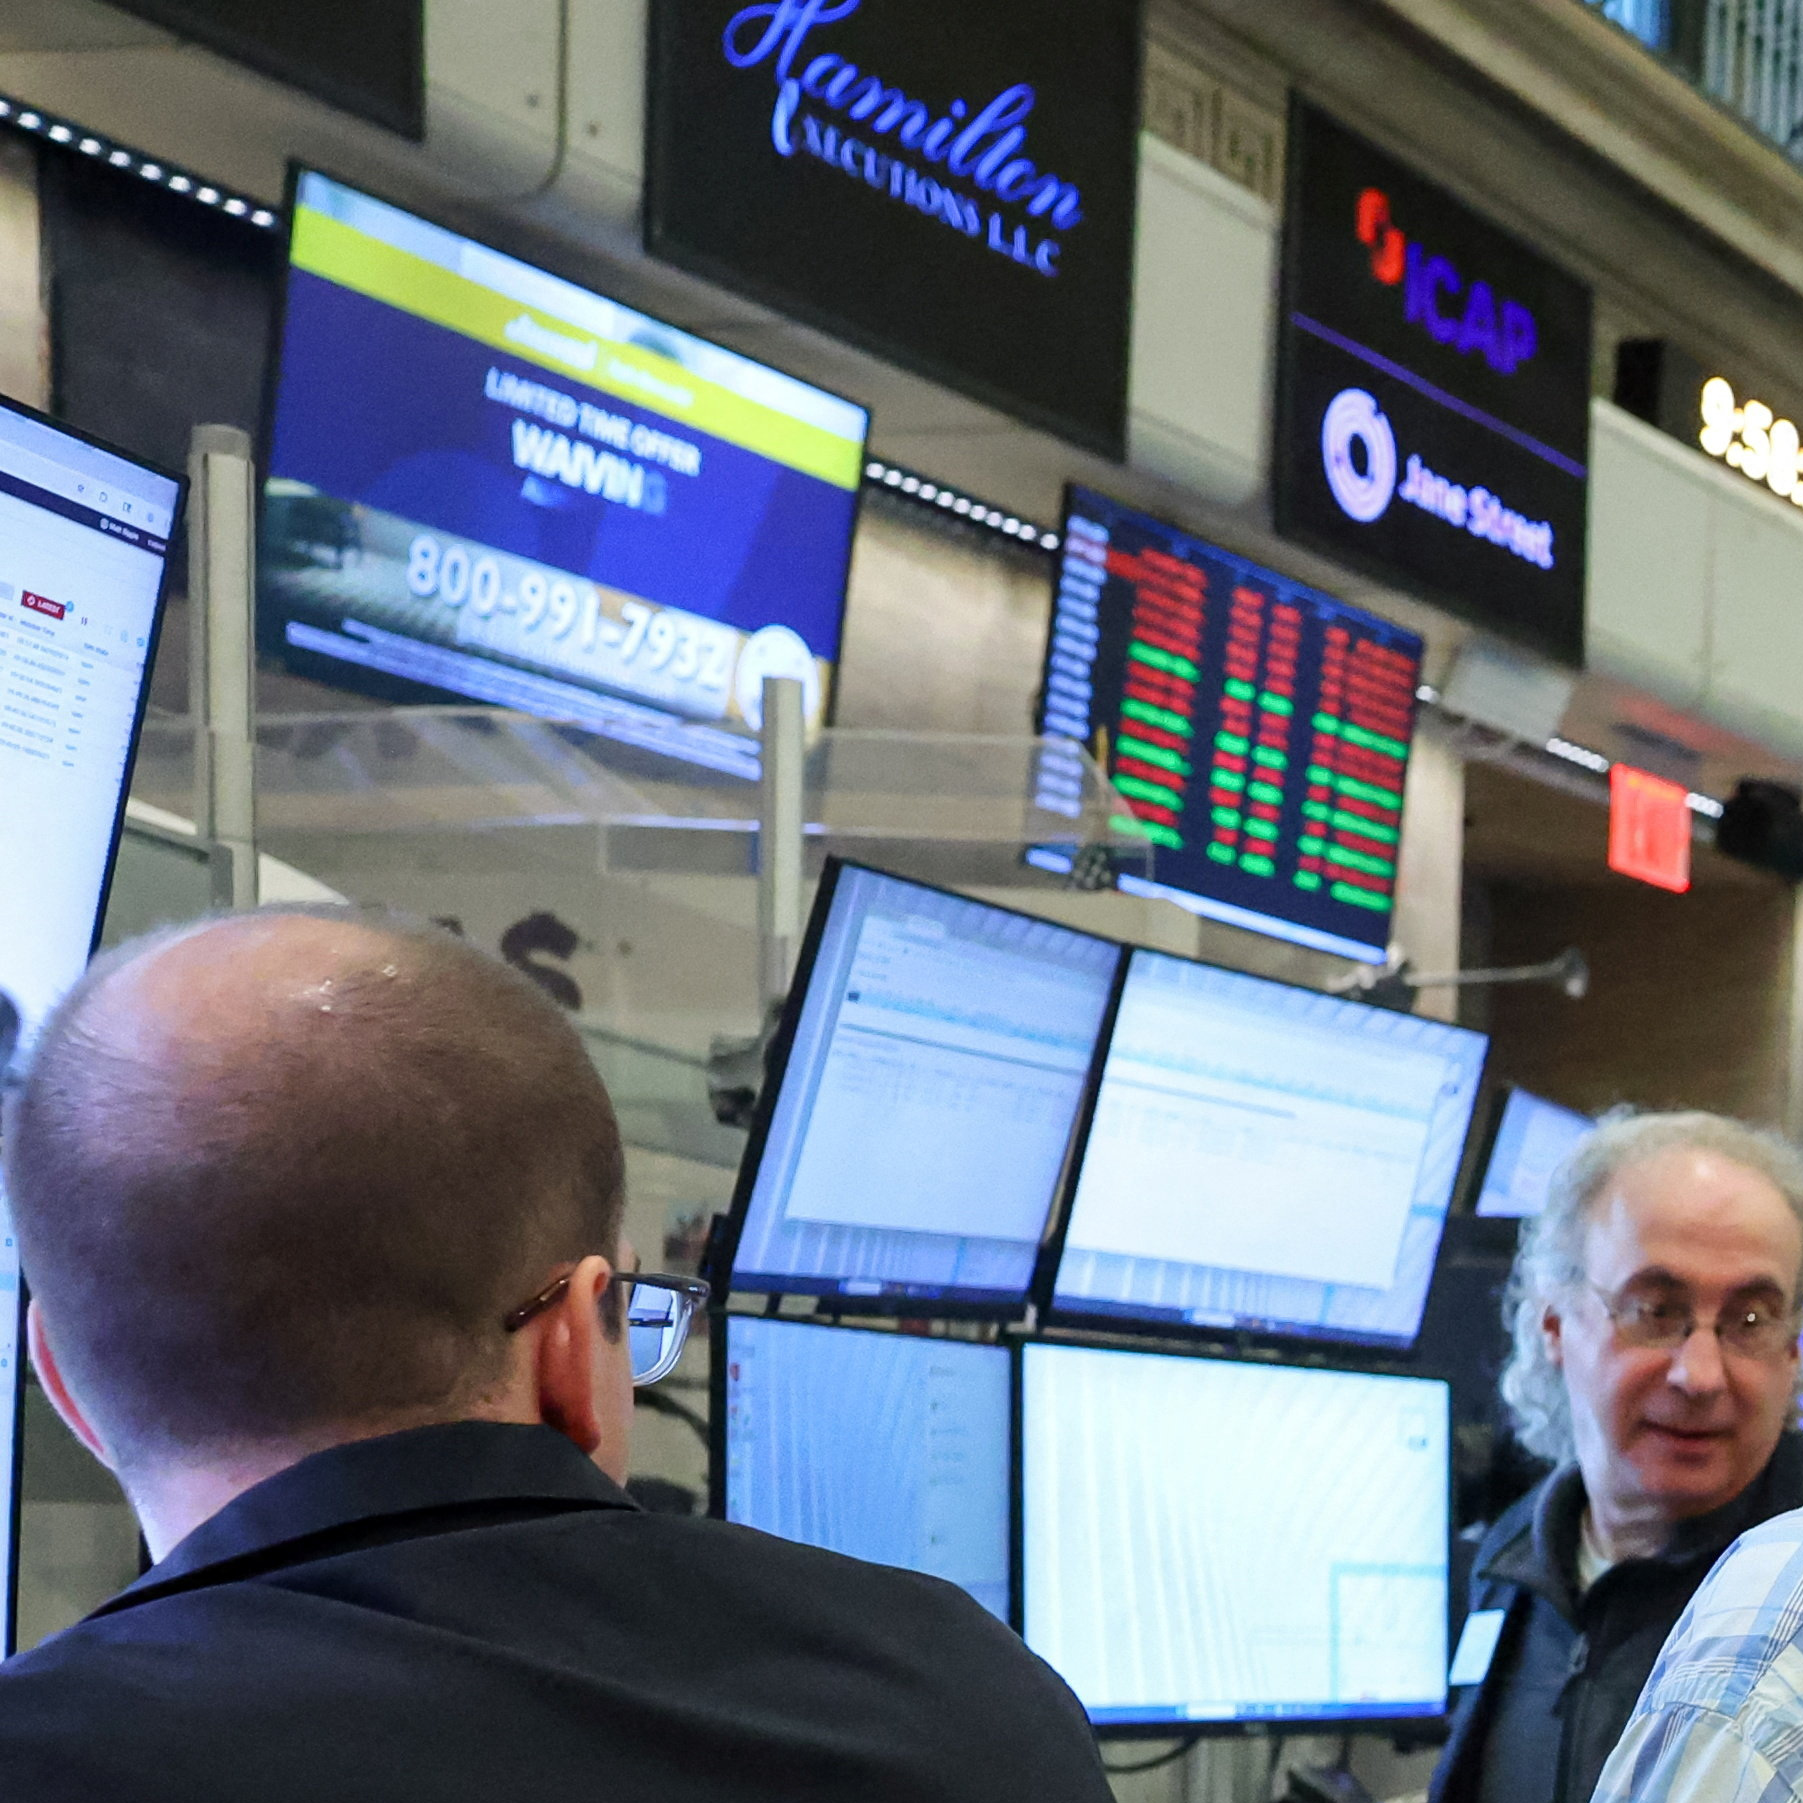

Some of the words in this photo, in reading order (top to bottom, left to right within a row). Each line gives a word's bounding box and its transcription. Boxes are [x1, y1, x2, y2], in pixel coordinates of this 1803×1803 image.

[722, 0, 1082, 230] Hamilton
[987, 212, 1061, 278] LLC
[1404, 242, 1538, 375] ICAP
[484, 366, 578, 429] LIMITED
[578, 402, 632, 451] TIME
[631, 423, 701, 478] OFFER
[1400, 452, 1468, 528] Jane
[1465, 485, 1555, 572] Street
[407, 533, 730, 692] 800-991-7932
